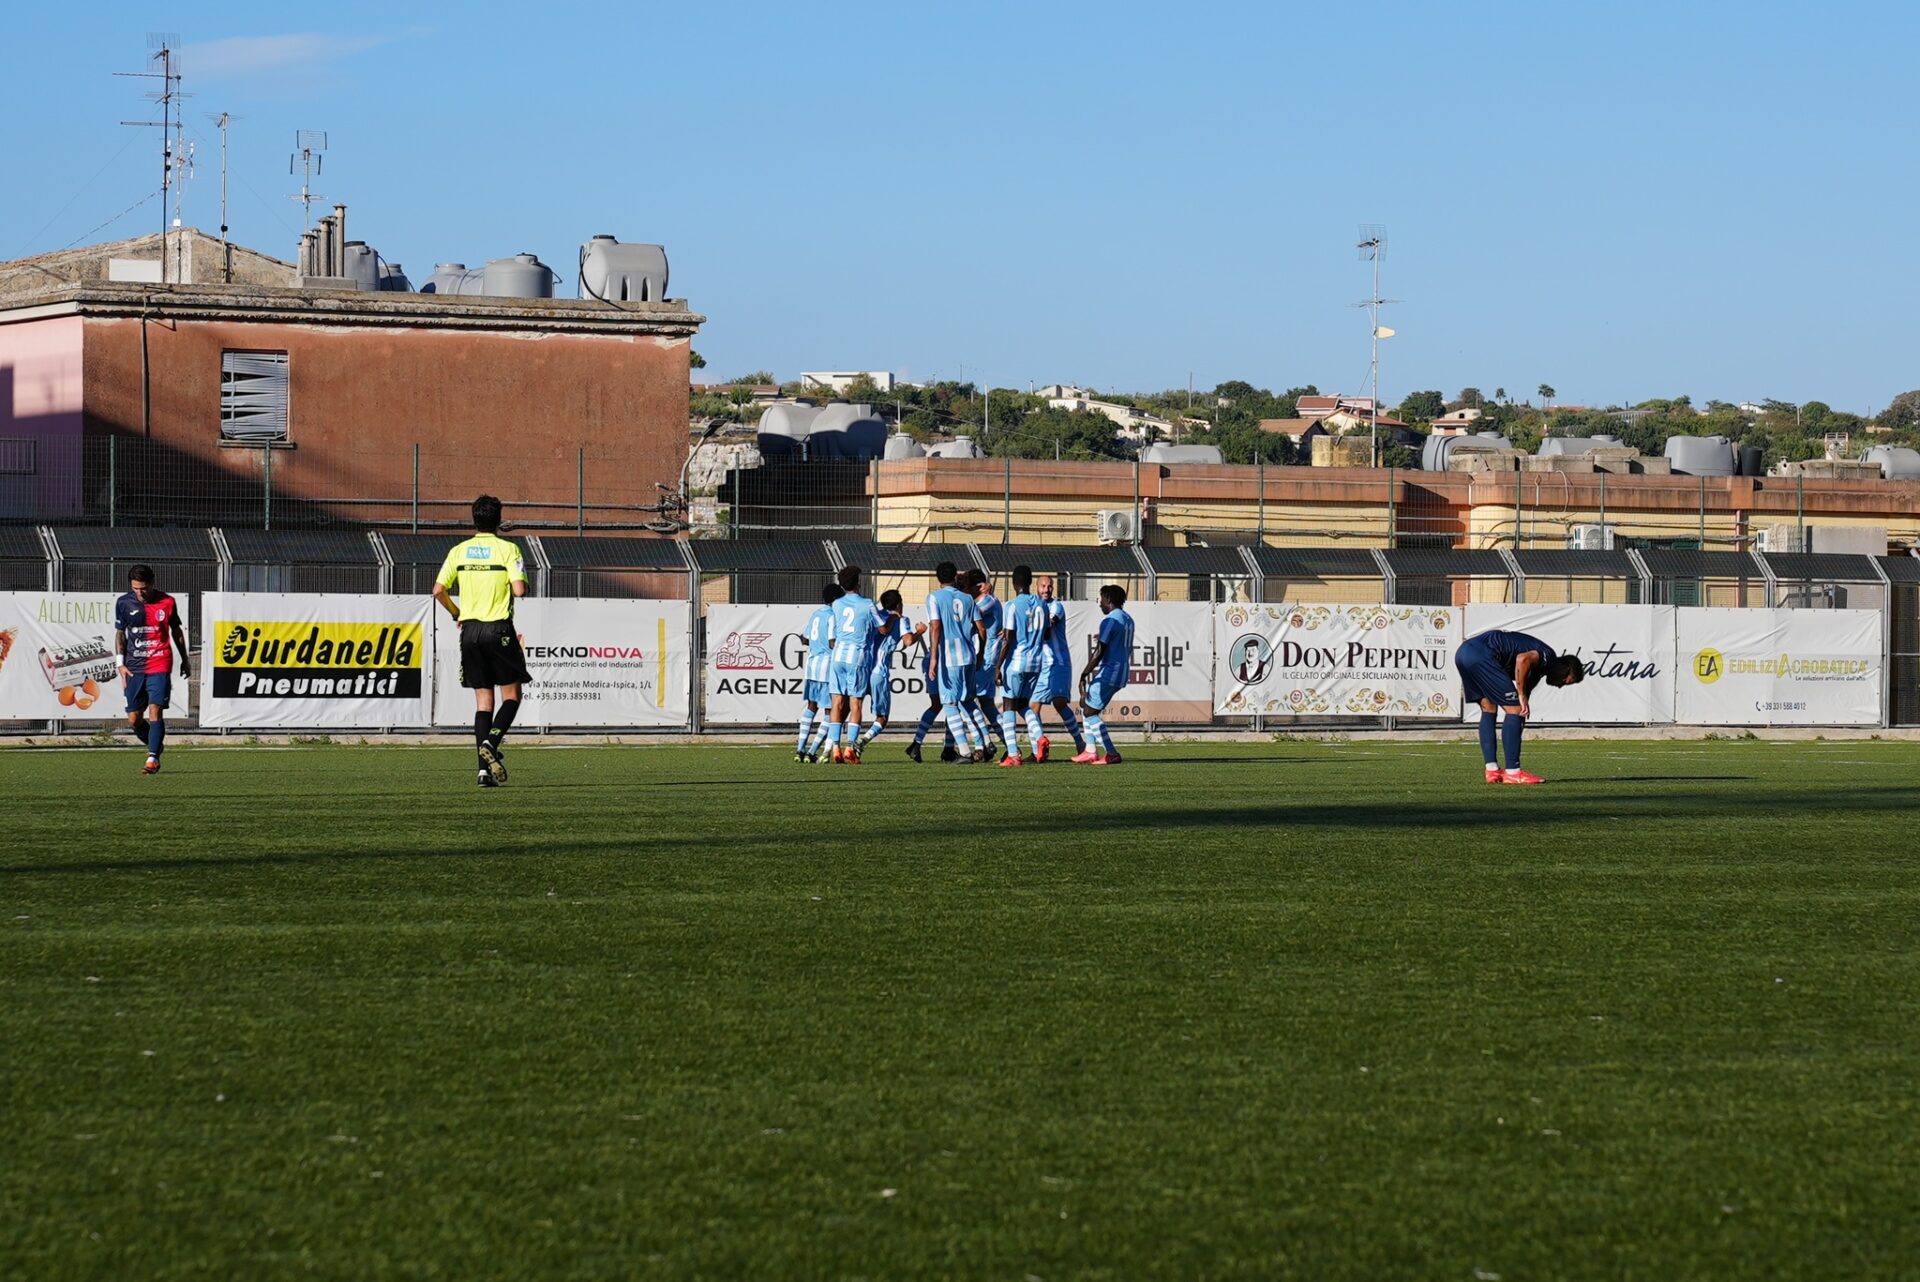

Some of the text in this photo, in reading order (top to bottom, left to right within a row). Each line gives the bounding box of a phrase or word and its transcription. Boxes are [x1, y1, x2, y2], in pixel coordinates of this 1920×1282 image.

[38, 598, 111, 624] ALLENATE
[842, 606, 855, 633] 2
[952, 598, 965, 623] 9
[810, 616, 820, 641] 8
[222, 625, 414, 667] Giurdanella
[525, 646, 643, 659] TEKNONOVA
[1281, 641, 1447, 670] DON PEPPINU
[525, 661, 552, 669] mpianti
[608, 661, 643, 669] industriali
[1562, 642, 1661, 681] atana
[1698, 655, 1719, 677] EA
[237, 671, 399, 695] Pneumatici
[528, 680, 541, 689] Via
[542, 681, 581, 689] Nazionale
[582, 681, 638, 690] Modica-Ispica,
[716, 678, 804, 695] AGENZ
[1282, 671, 1289, 679] IL
[1290, 671, 1320, 680] GELATO
[1320, 671, 1361, 680] ORIGINALE
[1362, 672, 1400, 680] SICILIANO
[1414, 673, 1423, 681] IN
[1424, 673, 1447, 682] ITALIA
